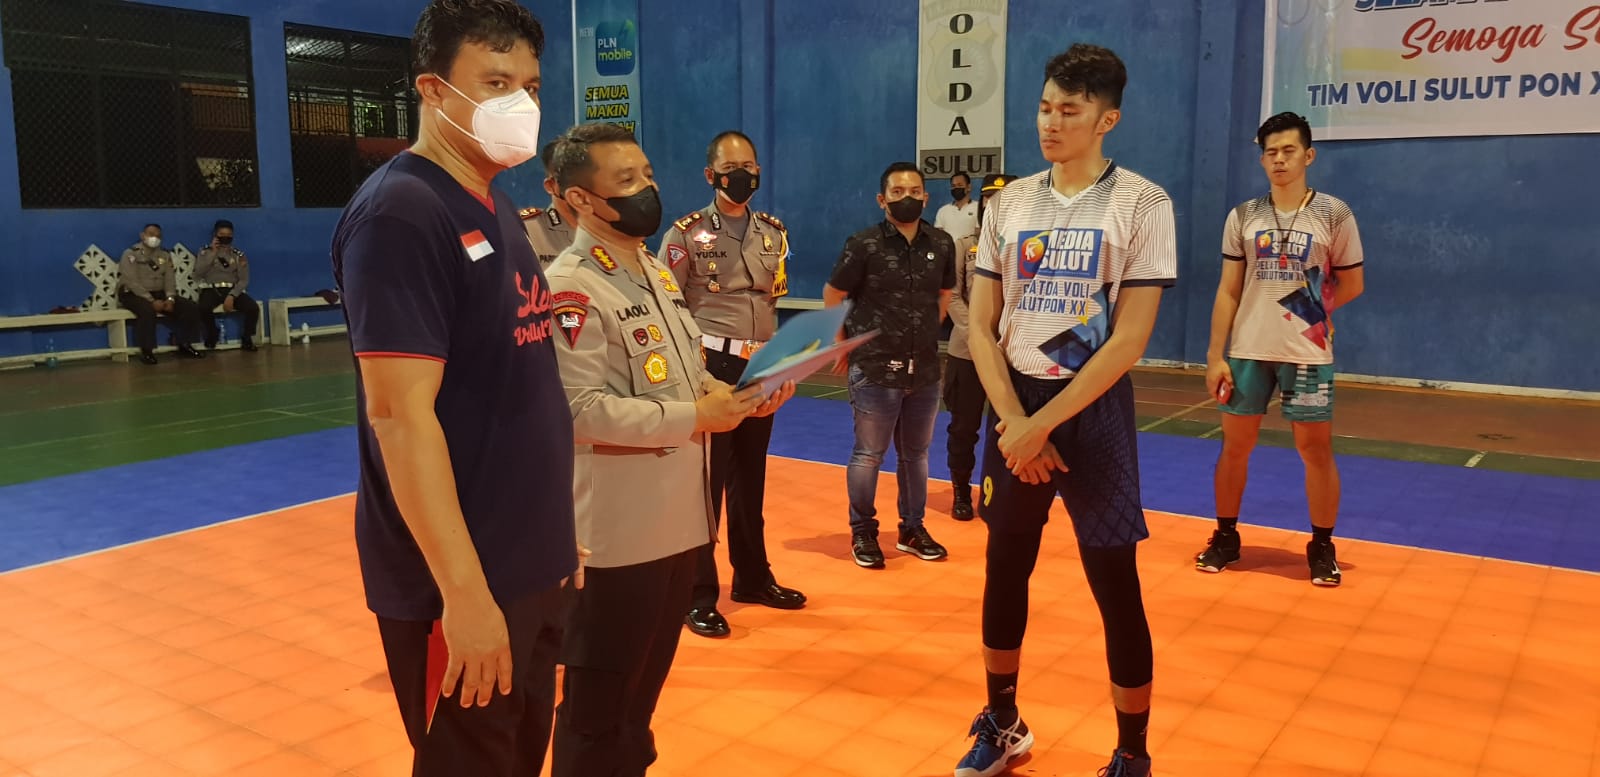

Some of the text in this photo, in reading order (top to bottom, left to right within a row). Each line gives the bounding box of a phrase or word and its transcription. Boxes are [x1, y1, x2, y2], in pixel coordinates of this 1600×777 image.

[598, 38, 617, 48] PLN
[1401, 5, 1600, 63] Semoga S
[598, 48, 632, 61] mobile
[585, 84, 629, 102] SEMUA
[1308, 83, 1348, 107] TIM
[1356, 79, 1417, 104] VOLI
[1424, 75, 1511, 101] SULUT
[1519, 71, 1581, 97] PON
[586, 103, 629, 120] MAKIN
[924, 153, 997, 176] SULUT
[1064, 281, 1090, 299] VOLI
[616, 303, 650, 321] LAOLI
[983, 475, 993, 507] 9
